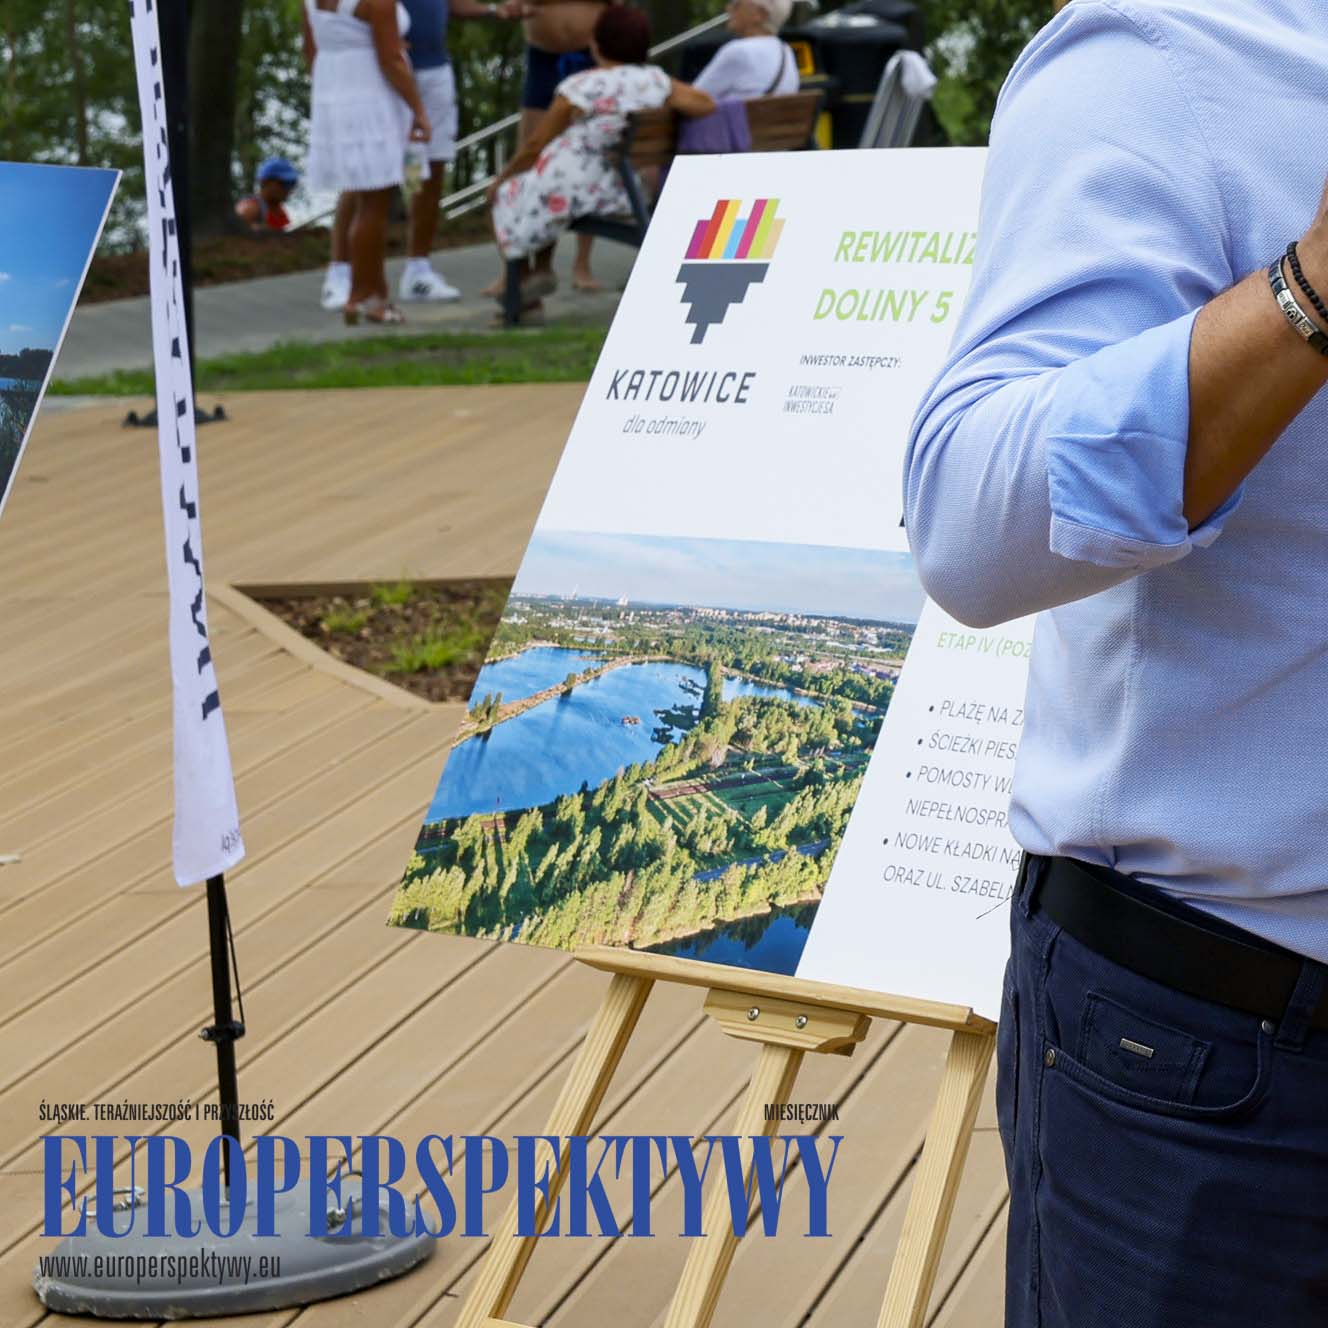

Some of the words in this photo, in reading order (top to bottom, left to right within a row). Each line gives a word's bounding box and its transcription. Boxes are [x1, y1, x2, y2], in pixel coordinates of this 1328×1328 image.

[834, 230, 977, 265] REWITALIZ
[812, 288, 928, 322] DOLINY
[929, 290, 953, 324] 5
[799, 354, 847, 367] INWESTOR
[606, 369, 757, 404] KATOWICE
[622, 414, 645, 433] dla
[646, 416, 706, 440] odmiany
[936, 631, 976, 650] ETAP
[977, 635, 994, 653] IV
[986, 706, 1008, 723] NA
[985, 739, 1017, 760] PIES
[917, 765, 992, 791] POMOSTY
[905, 798, 1008, 829] NIEPEŁNOSPR
[894, 831, 943, 854] NOWE
[943, 839, 998, 863] KŁADKI
[883, 864, 925, 886] ORAZ
